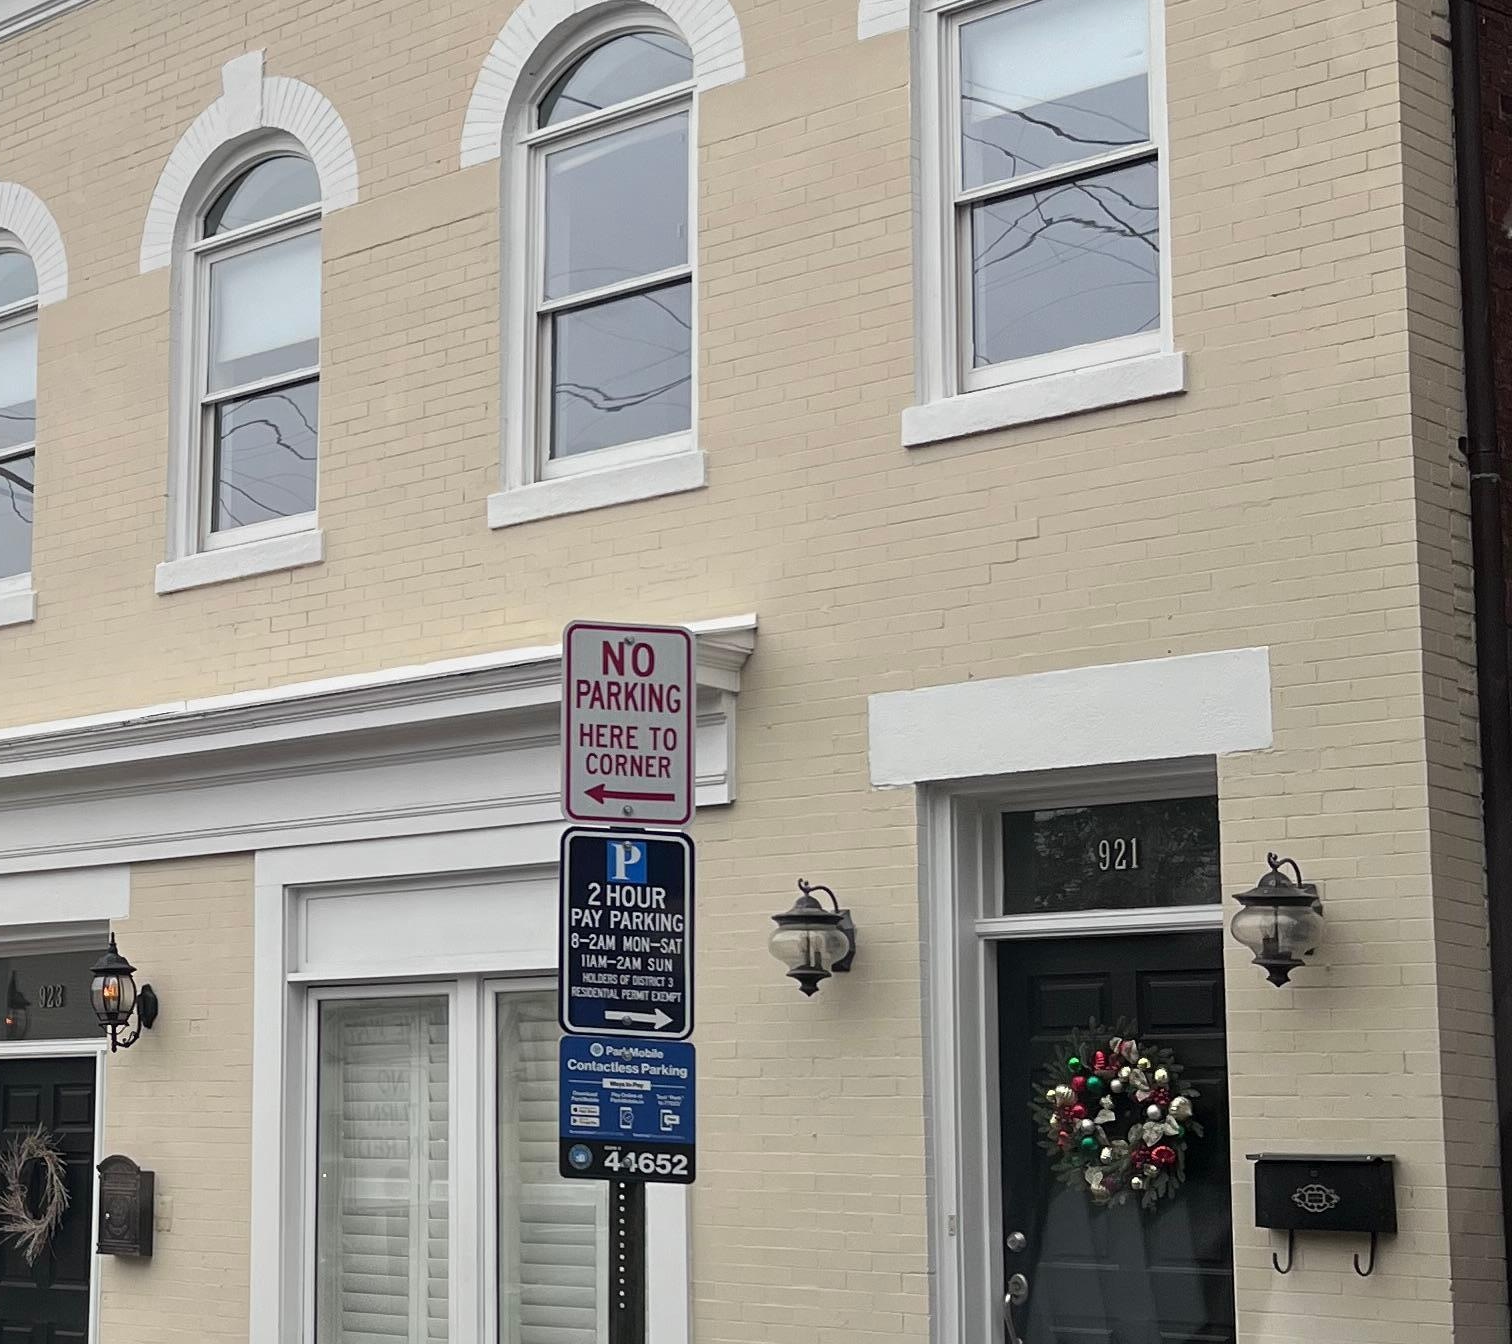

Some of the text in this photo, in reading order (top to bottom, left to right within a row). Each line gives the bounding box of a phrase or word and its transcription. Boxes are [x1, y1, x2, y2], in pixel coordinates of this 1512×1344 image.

[602, 640, 656, 678] NO
[575, 679, 681, 714] PARKING
[579, 723, 677, 751] HERE TO
[585, 752, 672, 778] CORNER
[1098, 837, 1139, 871] 921
[587, 882, 666, 909] 2 HOUR
[571, 908, 684, 932] PAY PARKING
[570, 933, 683, 955] 8-2AM MON-SAT
[581, 954, 673, 972] 11AM-2AM SUN
[582, 972, 674, 988] HOLDERS OF DISTRICT 3
[39, 984, 63, 1008] 923
[571, 986, 682, 1003] RESIDENTIAL PERMIT EXEMPT
[567, 1058, 688, 1078] Contactless Parking
[603, 1151, 688, 1175] 44652
